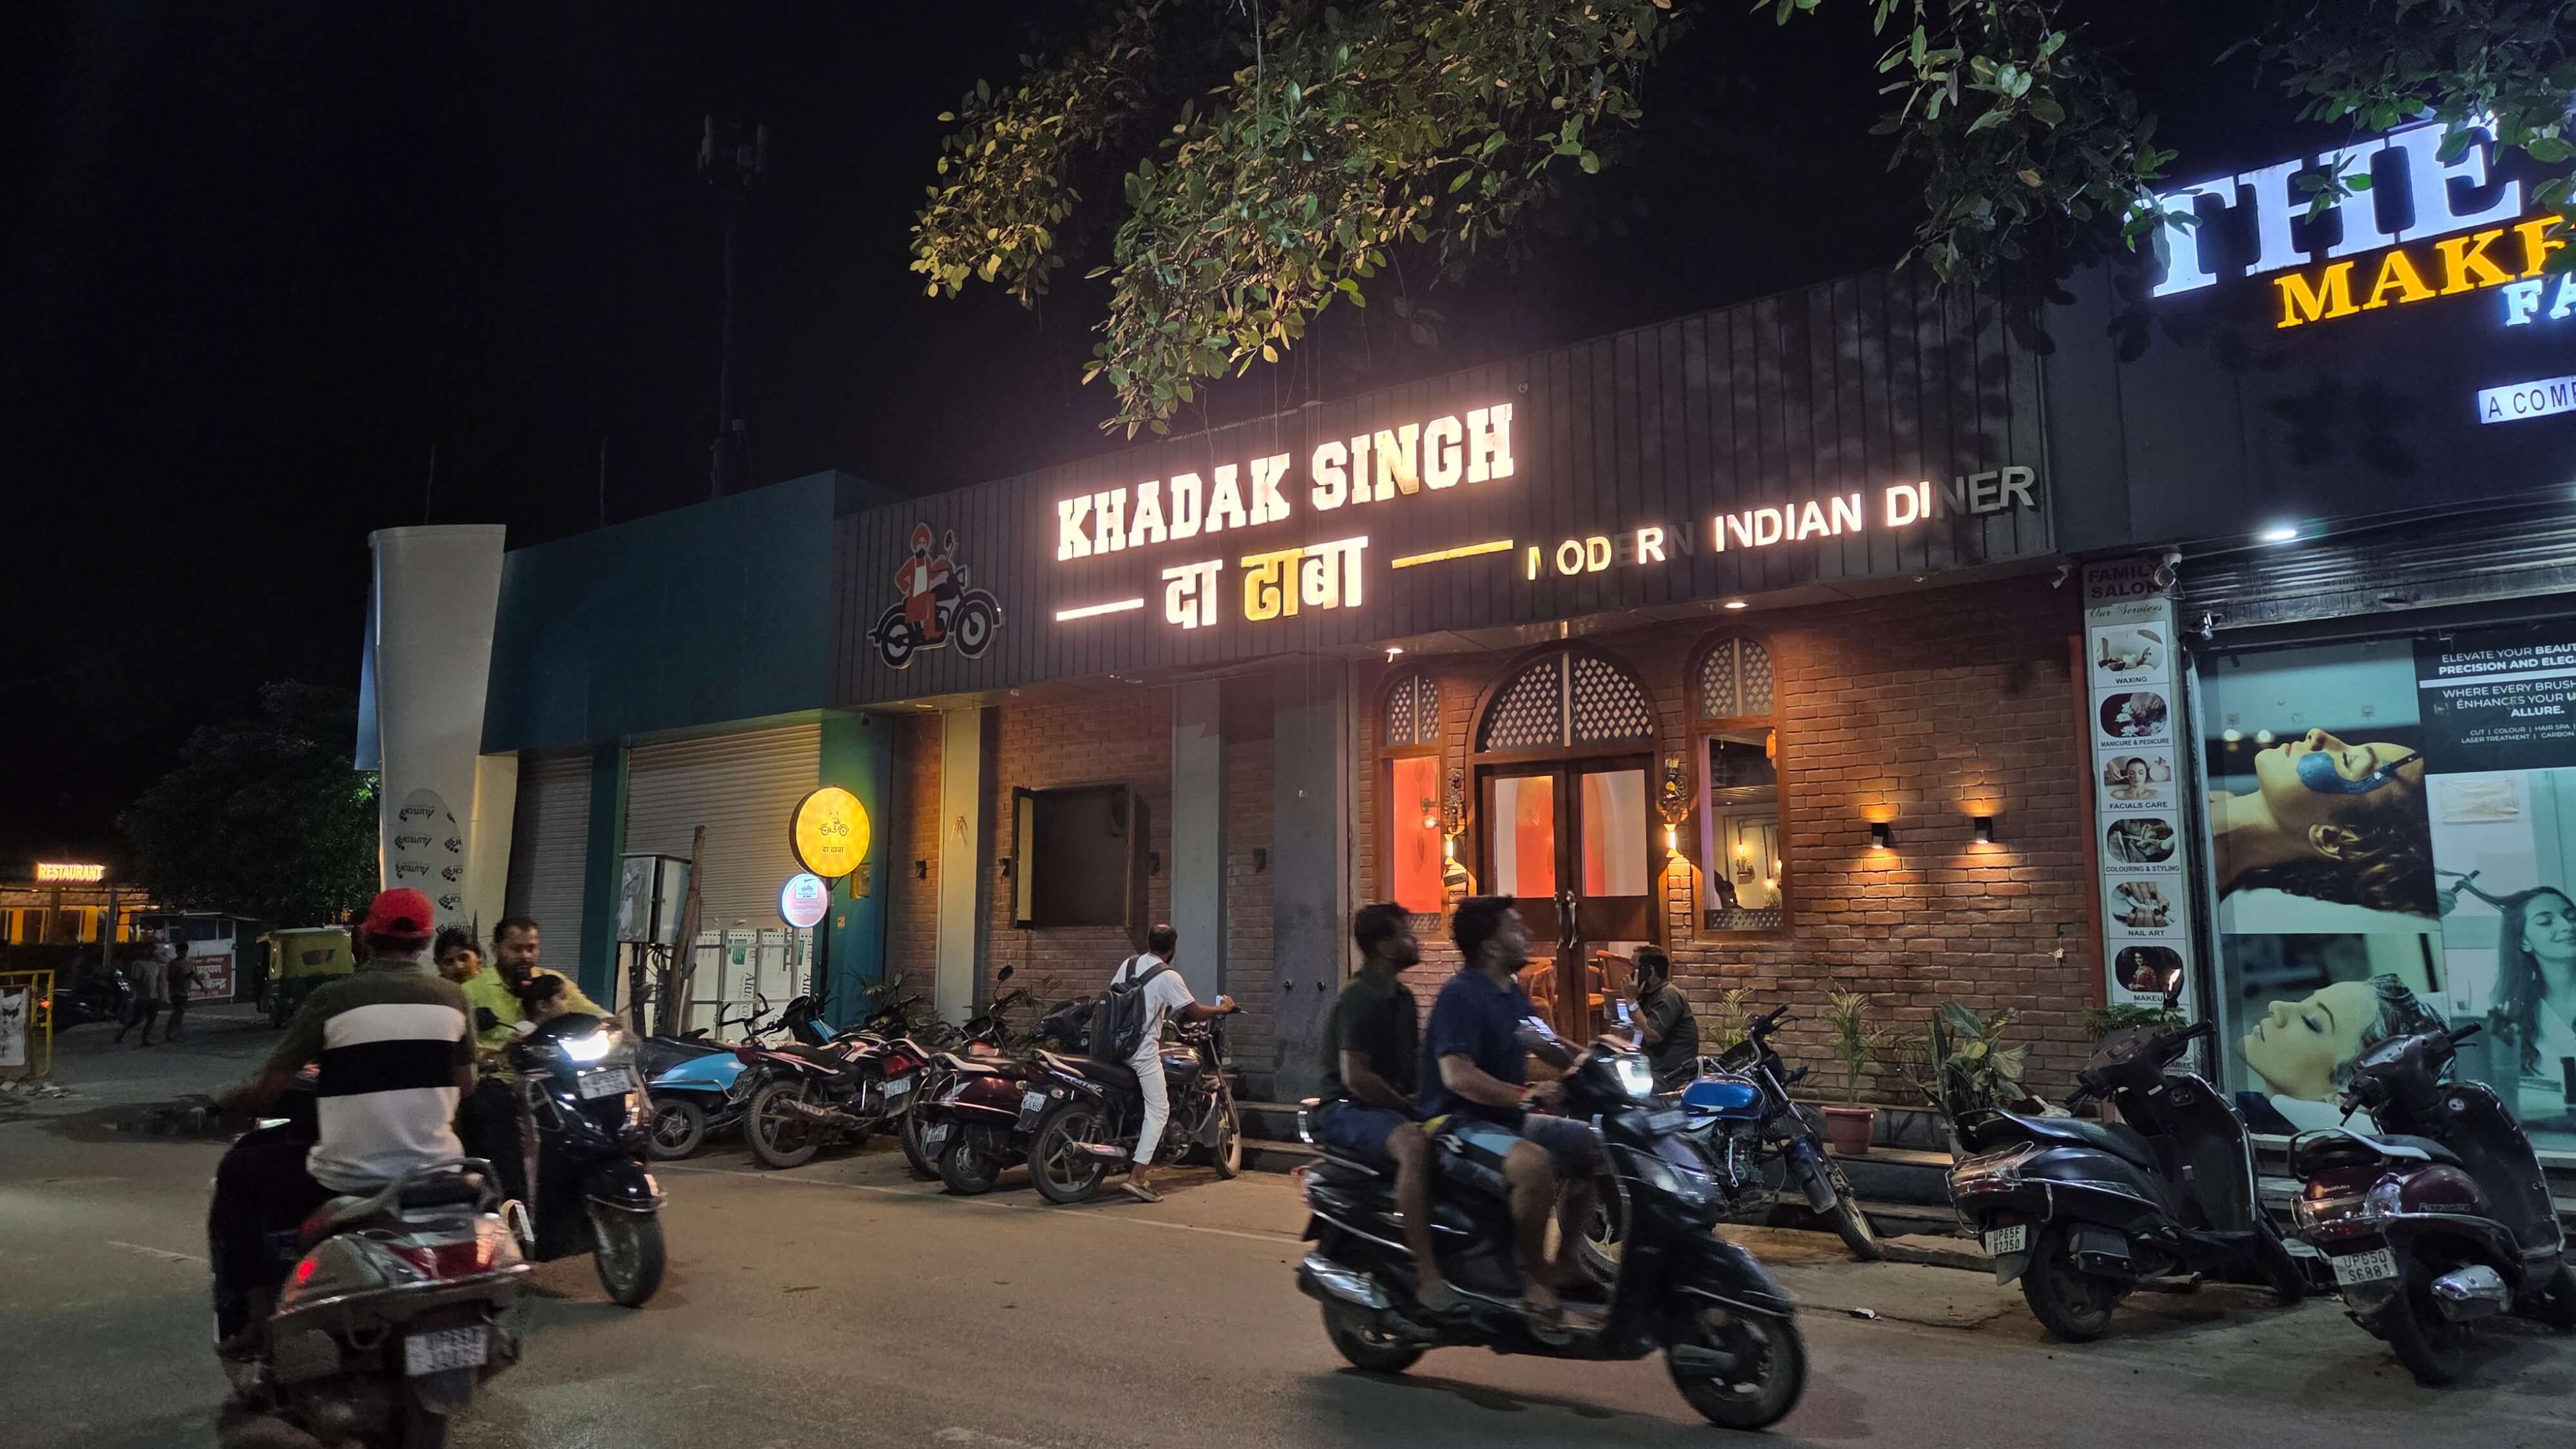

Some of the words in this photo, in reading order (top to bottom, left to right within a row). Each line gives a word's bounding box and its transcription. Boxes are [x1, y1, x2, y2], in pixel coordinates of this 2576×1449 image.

[2488, 395, 2503, 419] A
[2513, 381, 2576, 414] COM
[1057, 453, 1291, 562] KHADAK
[1311, 402, 1514, 512] SINGH
[1715, 493, 1862, 553] INDIAN
[1886, 466, 2036, 527] DINER
[1162, 558, 1223, 630] दा
[1240, 535, 1368, 622] ढाबा
[2118, 603, 2163, 616] Services
[2441, 650, 2494, 663] ELEVATE
[2496, 647, 2533, 658] YOUR
[2438, 661, 2507, 676] PRECISION
[2509, 658, 2539, 670] AND
[2115, 676, 2148, 685] WAXING
[2442, 687, 2490, 699] WHERE
[2492, 683, 2532, 695] EVERY
[2456, 695, 2526, 710] ENHANCES
[2527, 692, 2564, 704] YOUR
[2510, 705, 2565, 717] ALLURE.
[2485, 733, 2530, 743] TREATMENT
[2540, 730, 2575, 739] CARBON
[2493, 726, 2526, 734] COLOUR
[2534, 724, 2554, 732] HAIR
[2139, 737, 2170, 746] PEDICURE
[38, 864, 105, 880] RESTAURANT
[2152, 864, 2180, 873] STYLING
